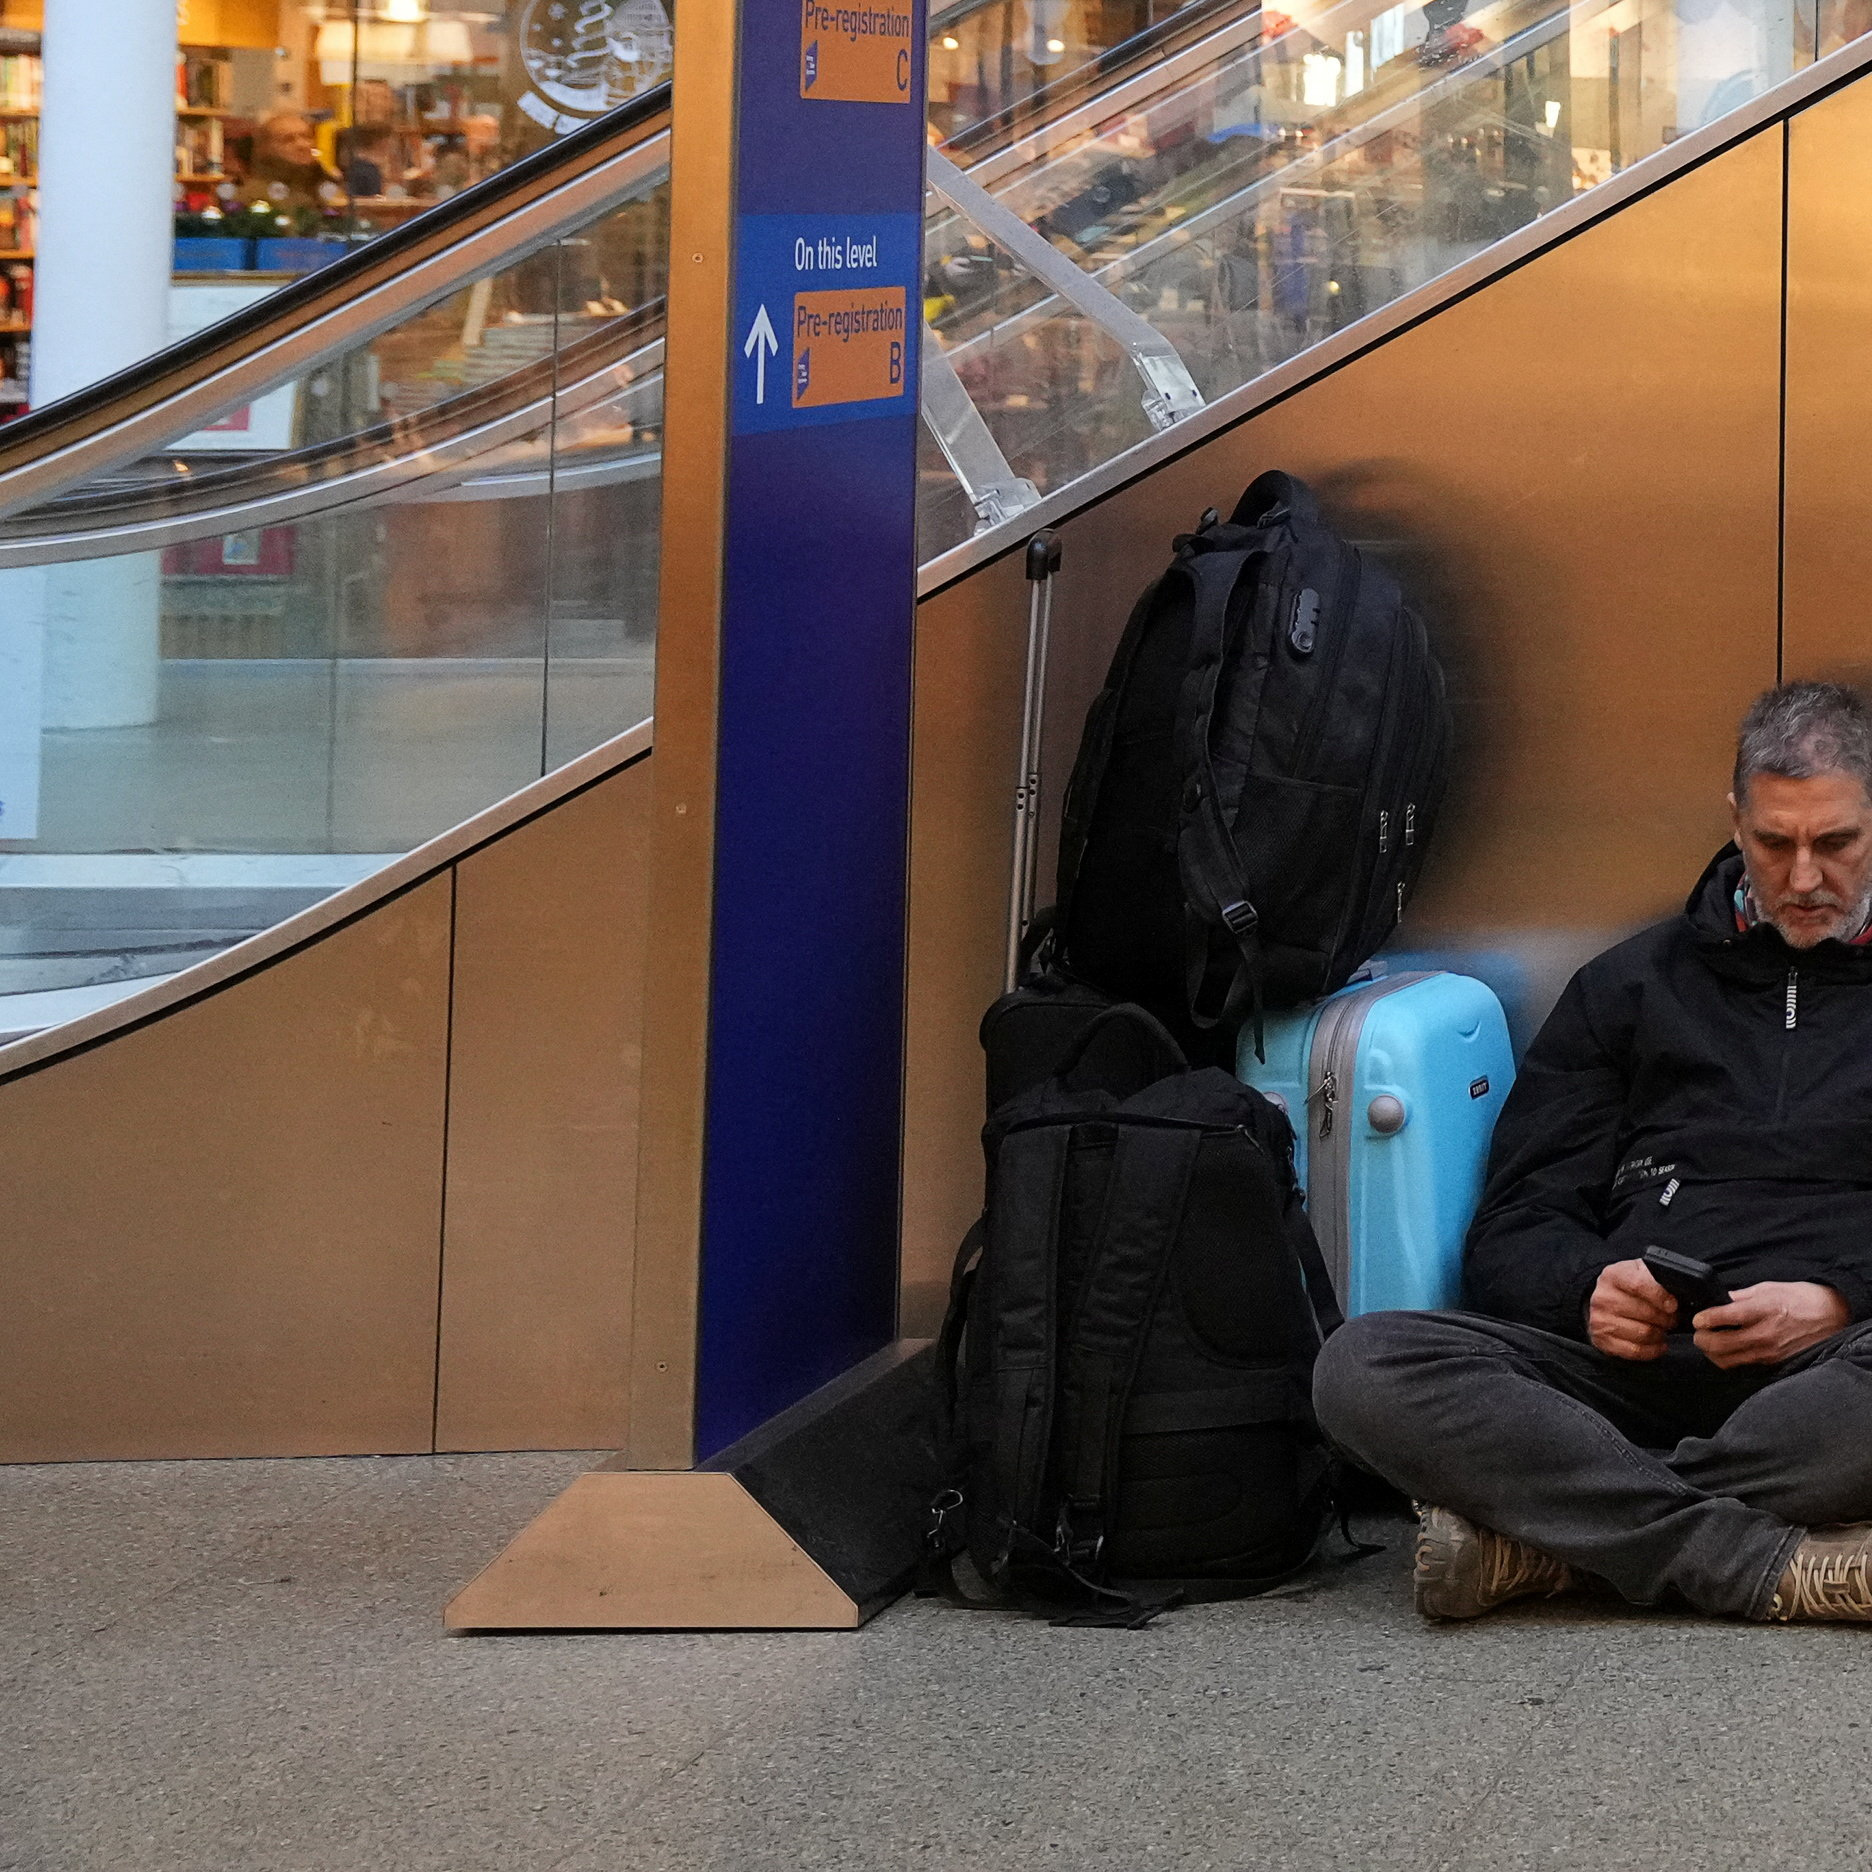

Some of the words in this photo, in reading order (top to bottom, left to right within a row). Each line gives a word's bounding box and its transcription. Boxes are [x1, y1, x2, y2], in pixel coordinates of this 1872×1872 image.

[896, 48, 909, 92] C
[794, 237, 814, 271] On
[817, 236, 843, 270] this
[846, 235, 878, 269] level
[797, 301, 902, 342] Pre-registration
[889, 341, 902, 385] B
